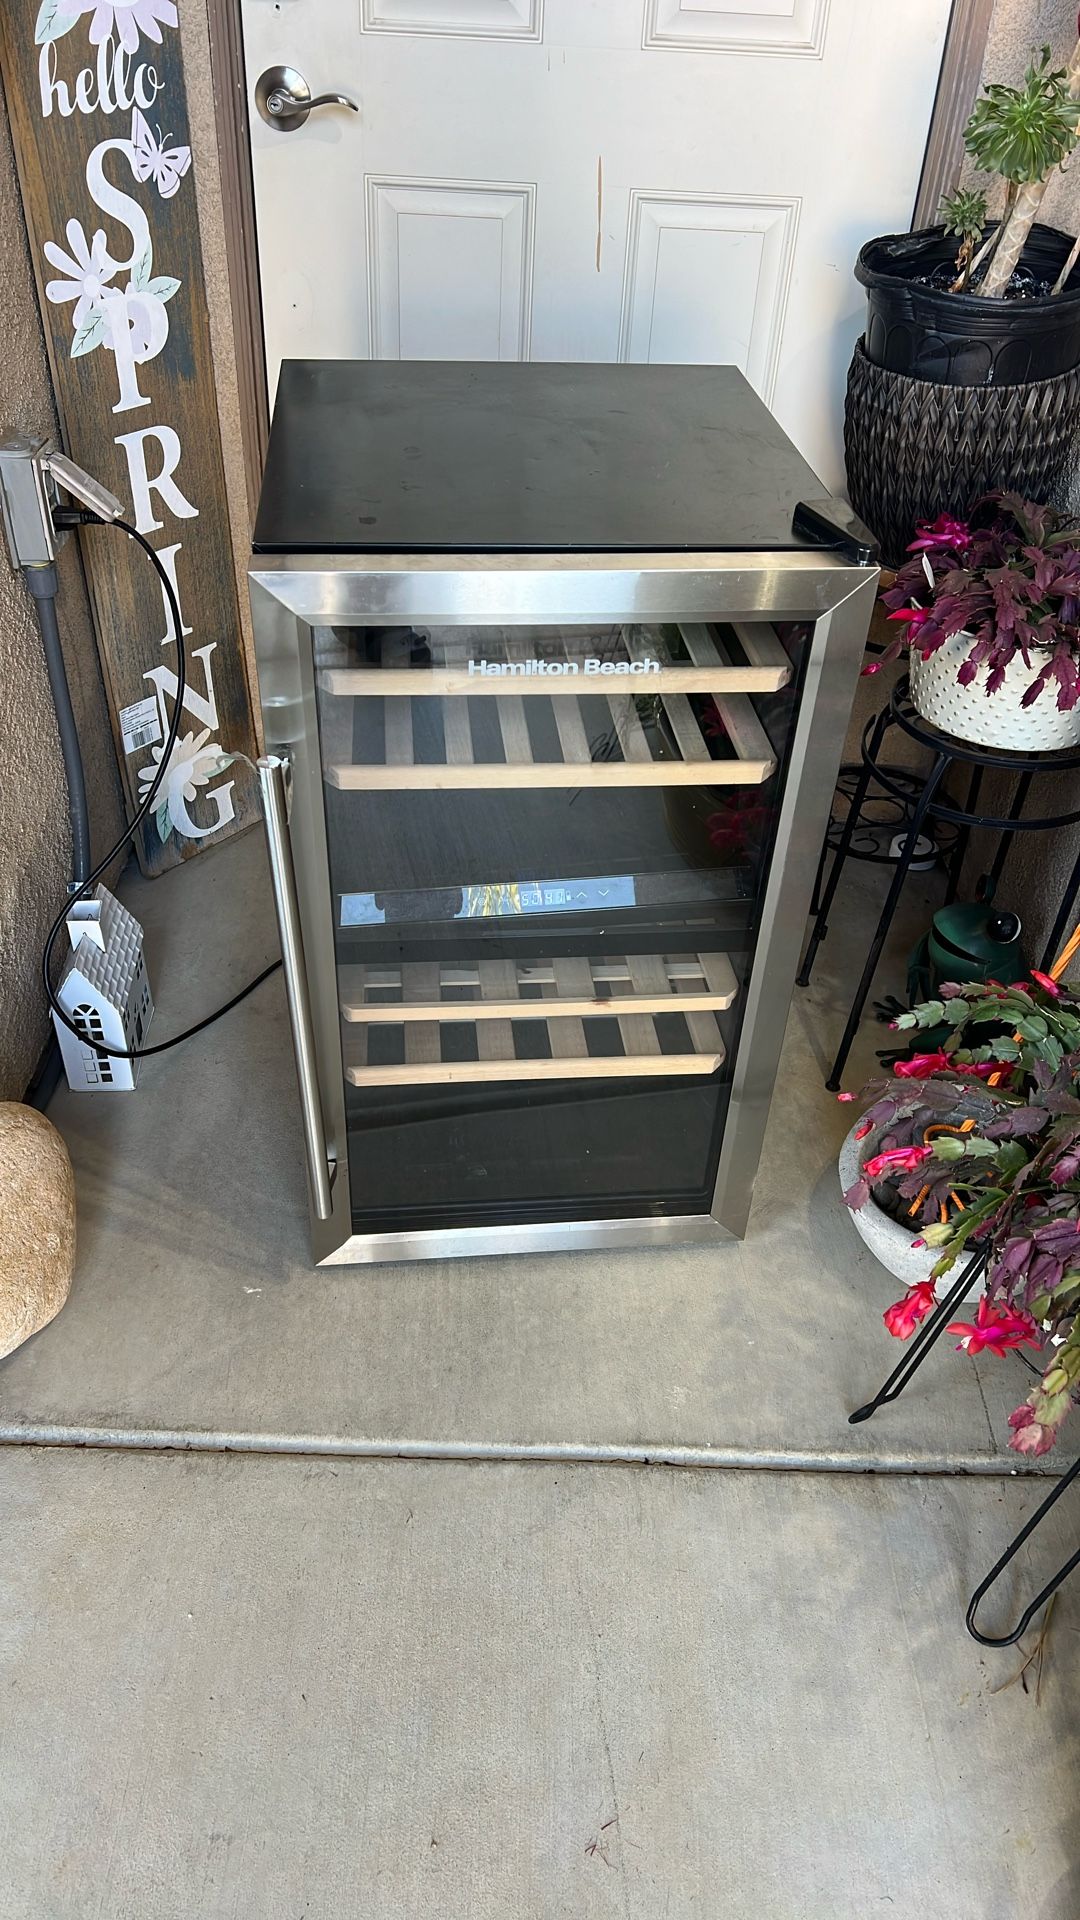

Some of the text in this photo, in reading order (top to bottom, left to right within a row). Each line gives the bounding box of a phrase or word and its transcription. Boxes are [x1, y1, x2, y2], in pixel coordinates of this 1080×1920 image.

[38, 33, 166, 118] hello
[86, 138, 236, 839] SPRING
[468, 658, 660, 676] Hamilton Beach
